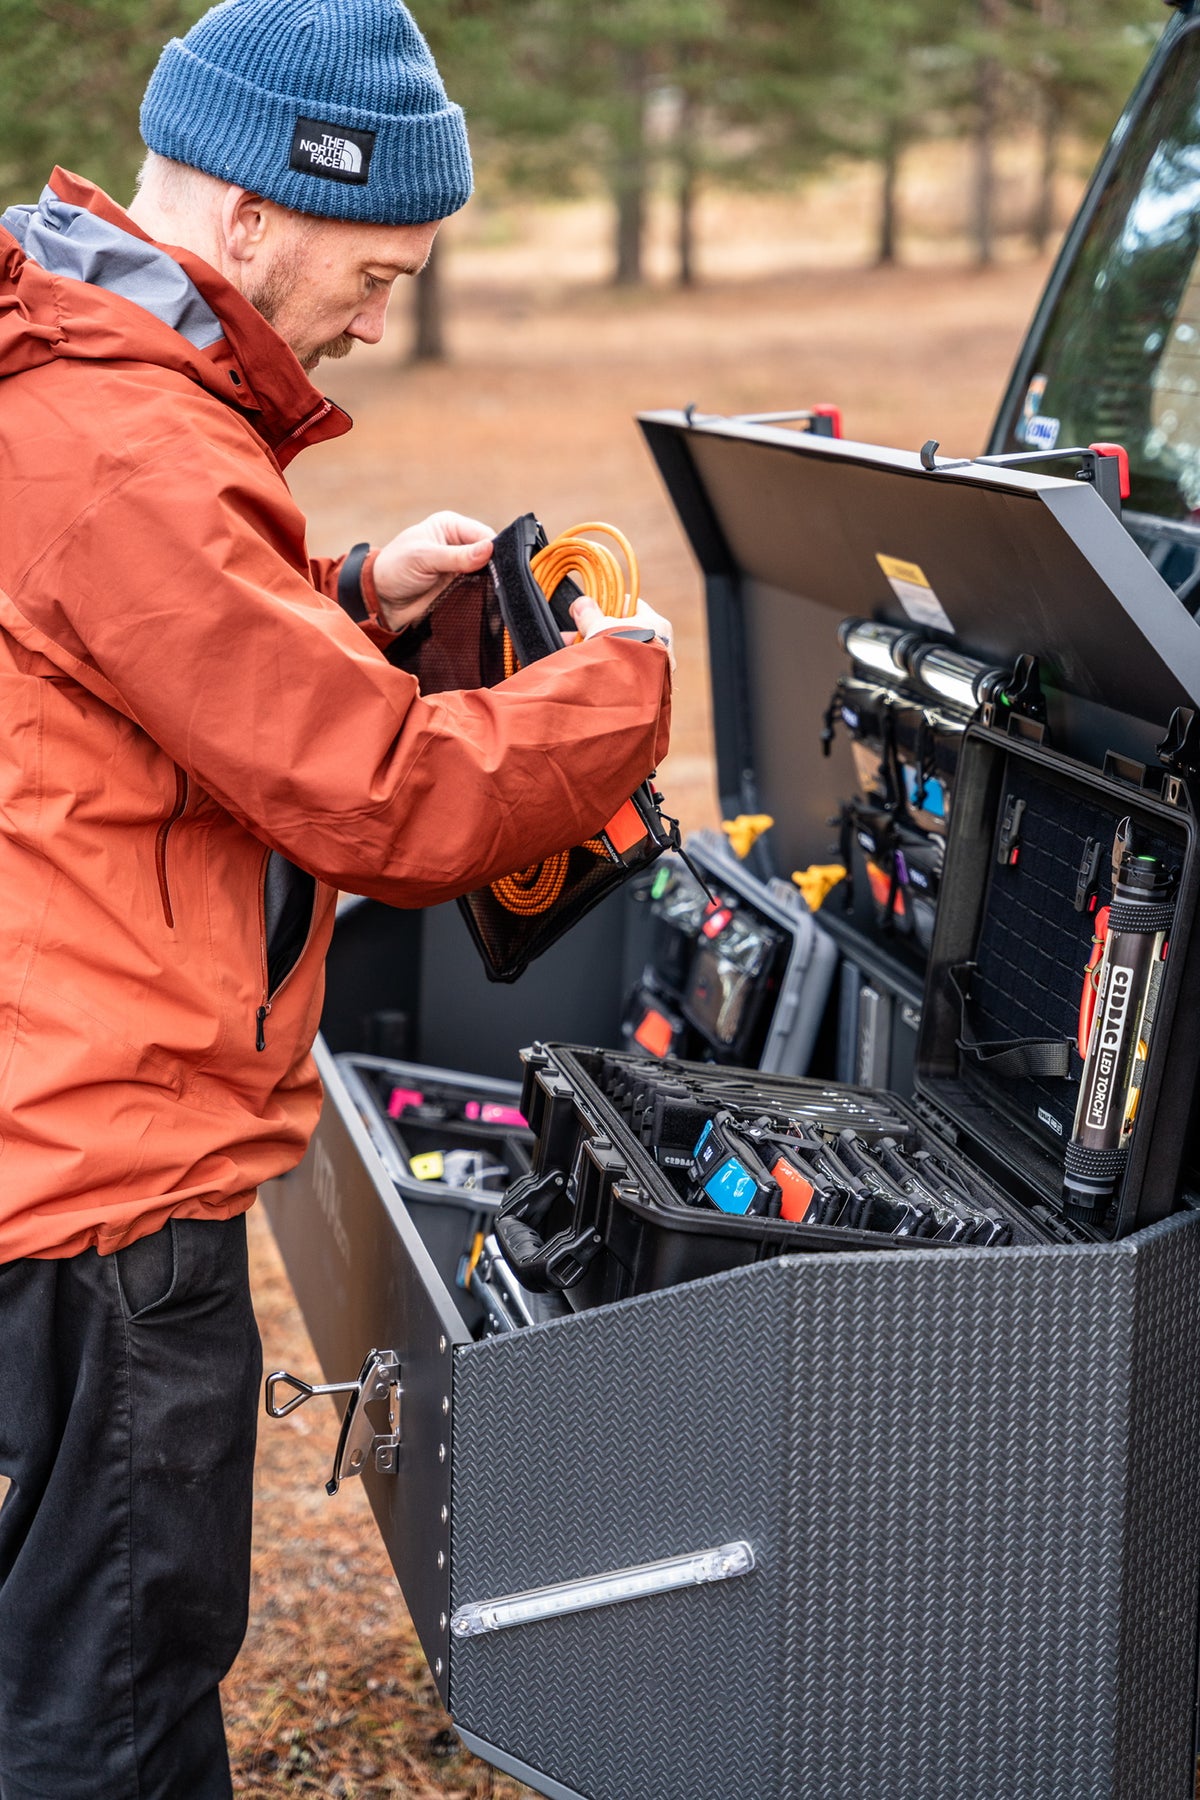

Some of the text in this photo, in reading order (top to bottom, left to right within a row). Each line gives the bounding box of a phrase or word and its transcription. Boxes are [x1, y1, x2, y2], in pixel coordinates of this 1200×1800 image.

[300, 139, 342, 159] NORTH
[322, 134, 345, 149] THE
[310, 153, 341, 169] FACE
[1100, 1051, 1113, 1075] LED
